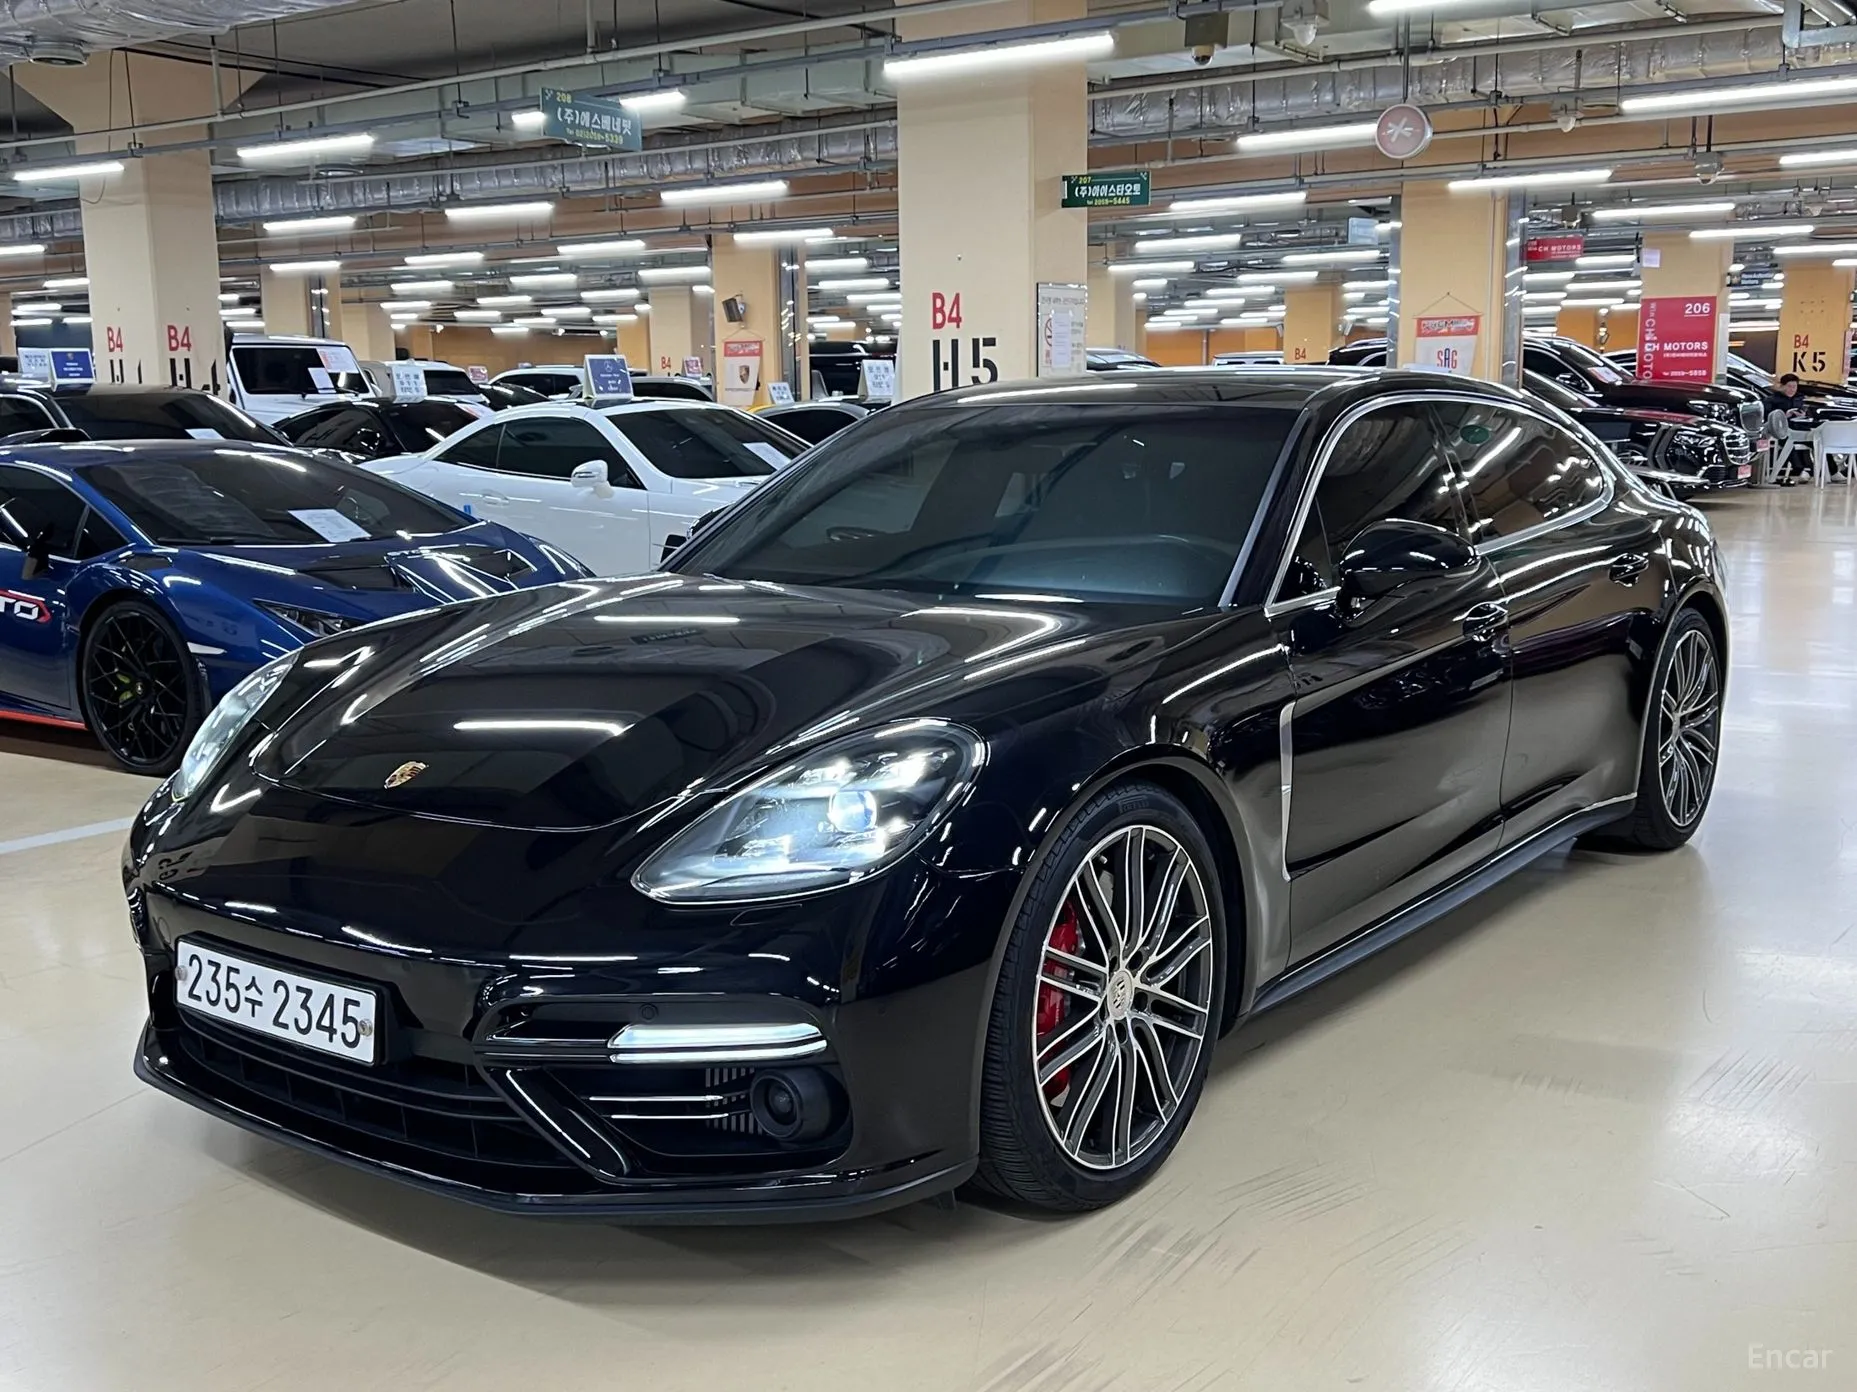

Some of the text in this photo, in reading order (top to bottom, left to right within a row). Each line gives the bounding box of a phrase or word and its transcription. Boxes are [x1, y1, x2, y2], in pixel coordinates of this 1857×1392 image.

[556, 92, 572, 104] 208
[1078, 176, 1092, 184] 207
[932, 292, 962, 329] B4
[1684, 302, 1711, 315] 206
[107, 326, 123, 352] B4
[167, 324, 192, 351] B4
[1793, 334, 1809, 349] B4
[1663, 341, 1709, 351] MOTORS
[1294, 347, 1306, 360] B4
[1436, 347, 1458, 369] SAG
[661, 356, 672, 369] B4
[187, 953, 361, 1049] 235수 2345
